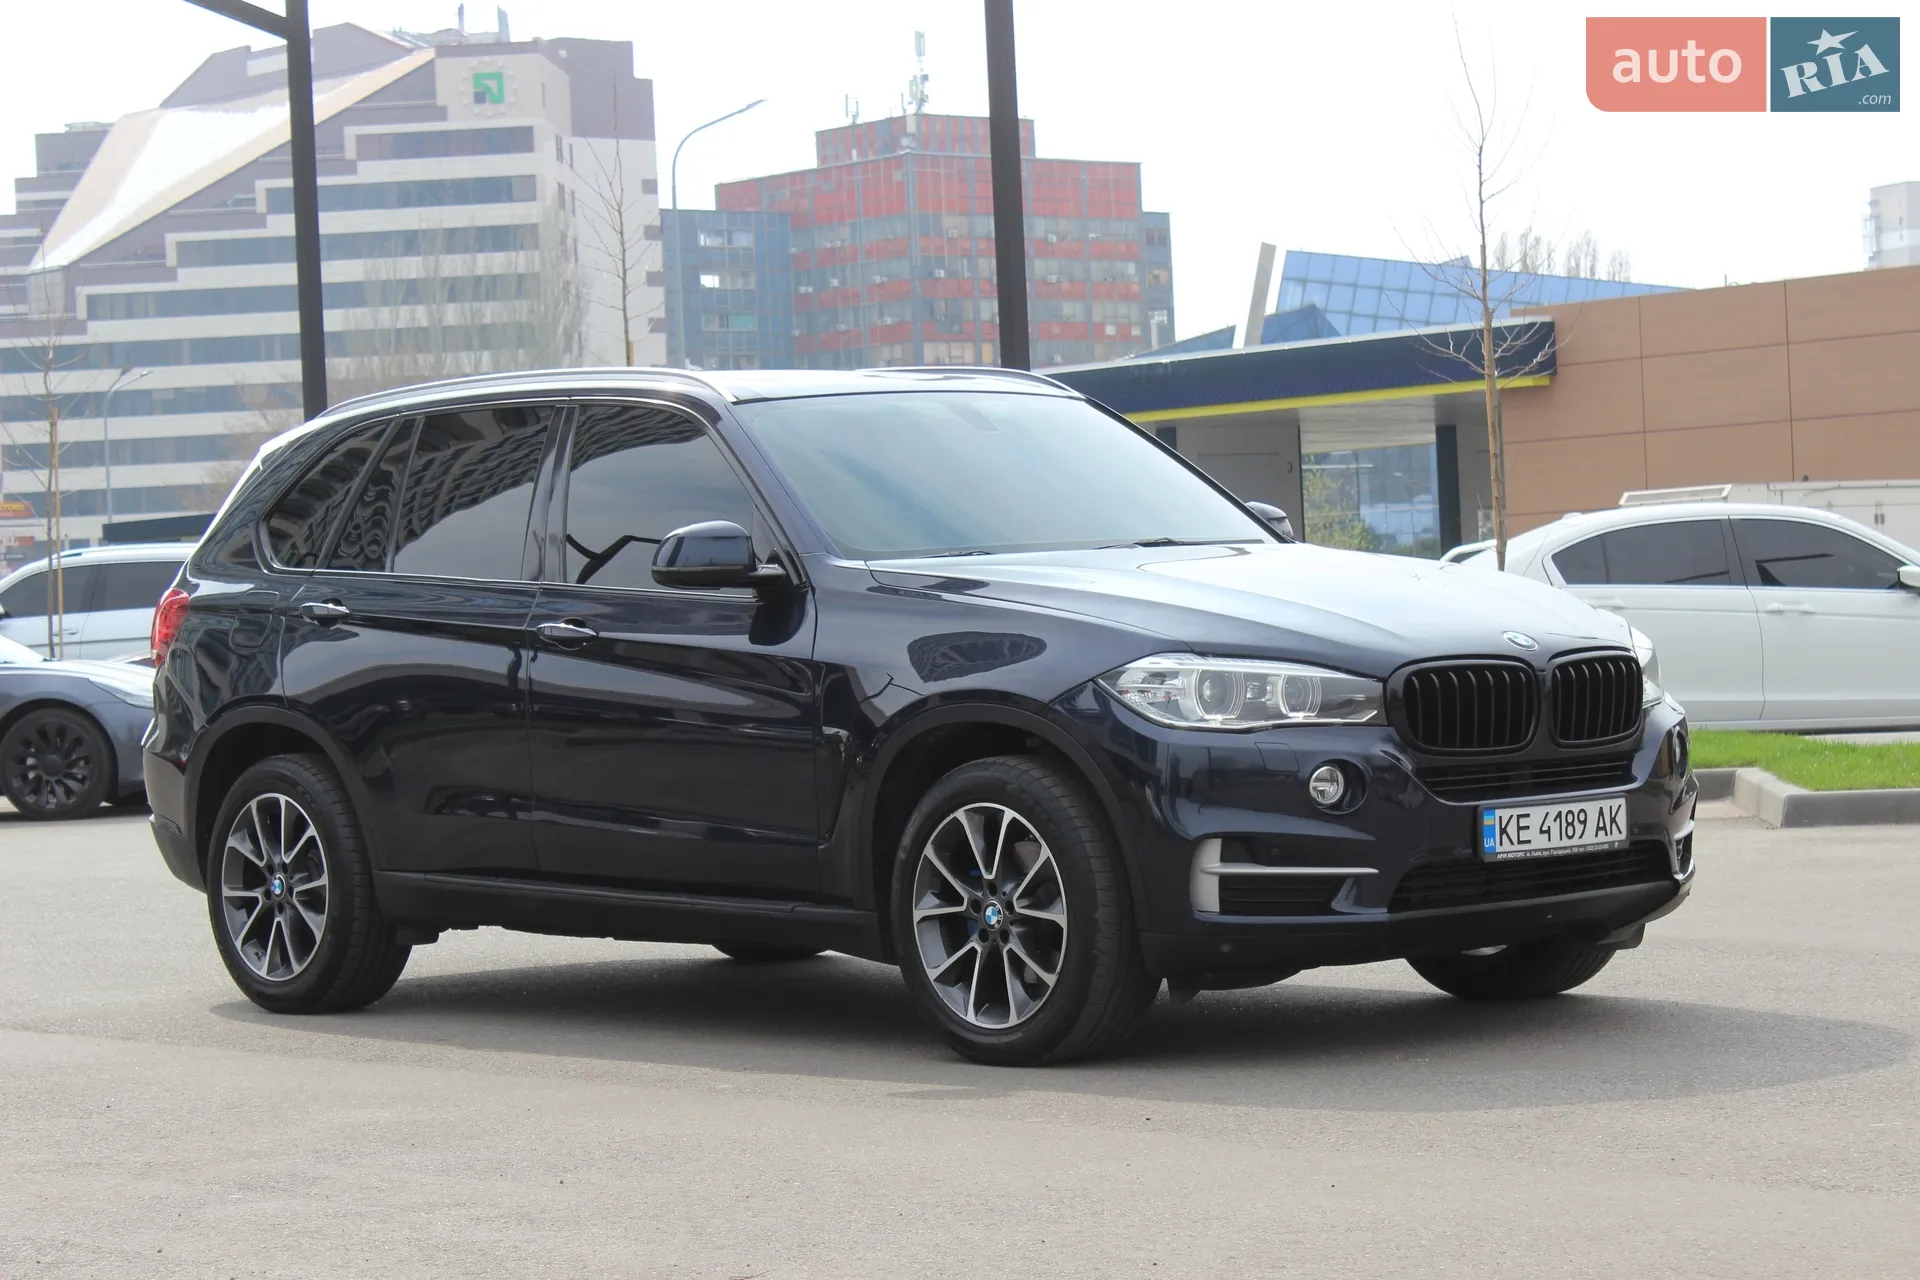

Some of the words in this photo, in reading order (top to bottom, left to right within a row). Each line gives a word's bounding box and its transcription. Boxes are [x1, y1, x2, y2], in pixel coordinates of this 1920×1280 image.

[1499, 813, 1532, 847] KE
[1539, 808, 1588, 842] 4189
[1594, 804, 1623, 838] AK
[1484, 838, 1495, 848] UA
